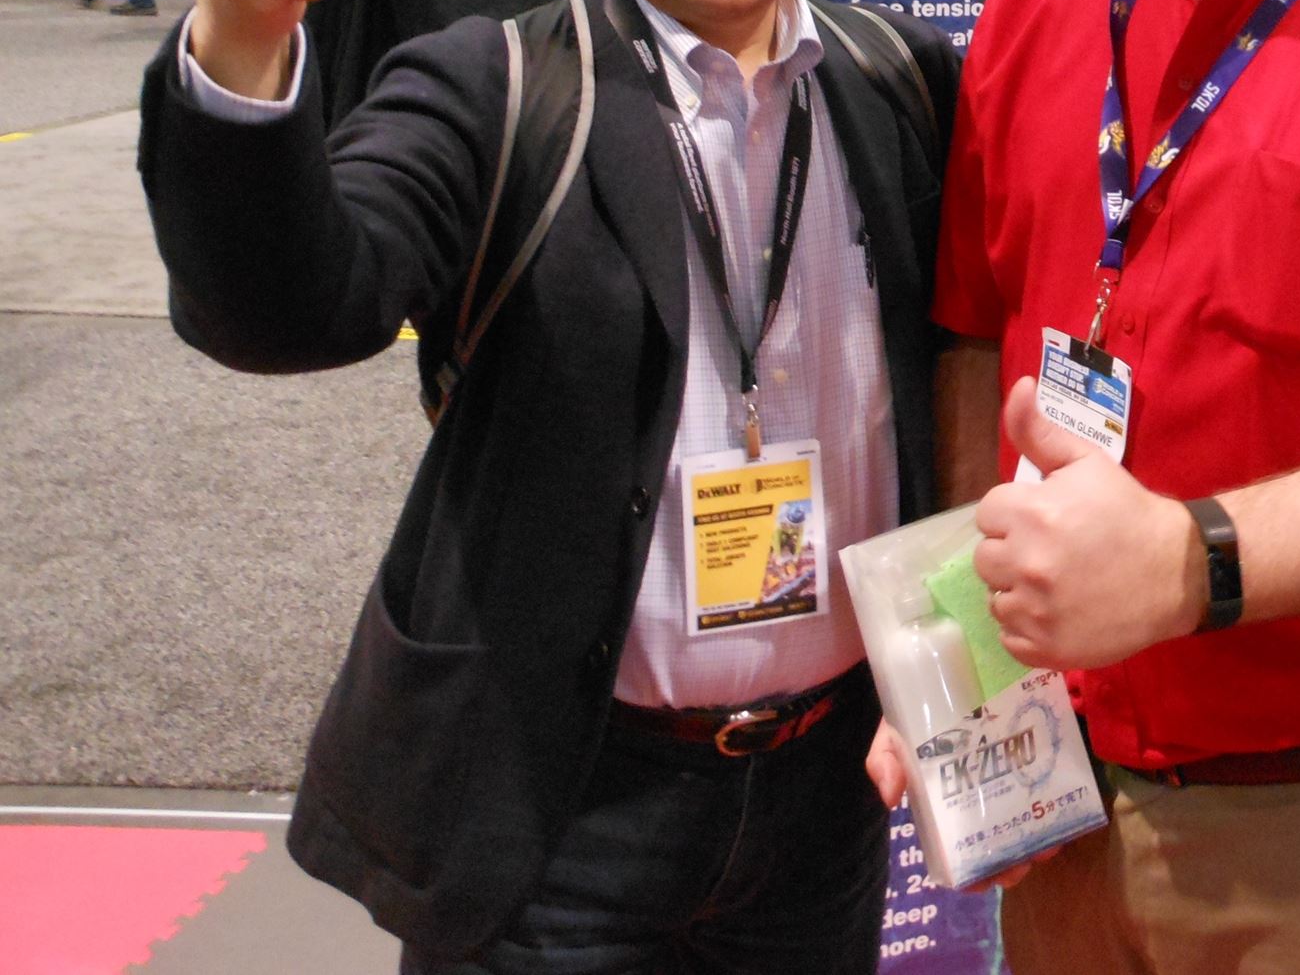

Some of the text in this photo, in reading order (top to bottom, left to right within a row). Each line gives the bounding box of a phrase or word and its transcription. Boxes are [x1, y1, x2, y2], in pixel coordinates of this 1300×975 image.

[1191, 82, 1220, 113] SKOL
[1107, 190, 1123, 220] SKOL
[1046, 405, 1075, 427] KELTON
[1078, 421, 1112, 447] GLEWWE
[940, 726, 1037, 801] EK-ZERO
